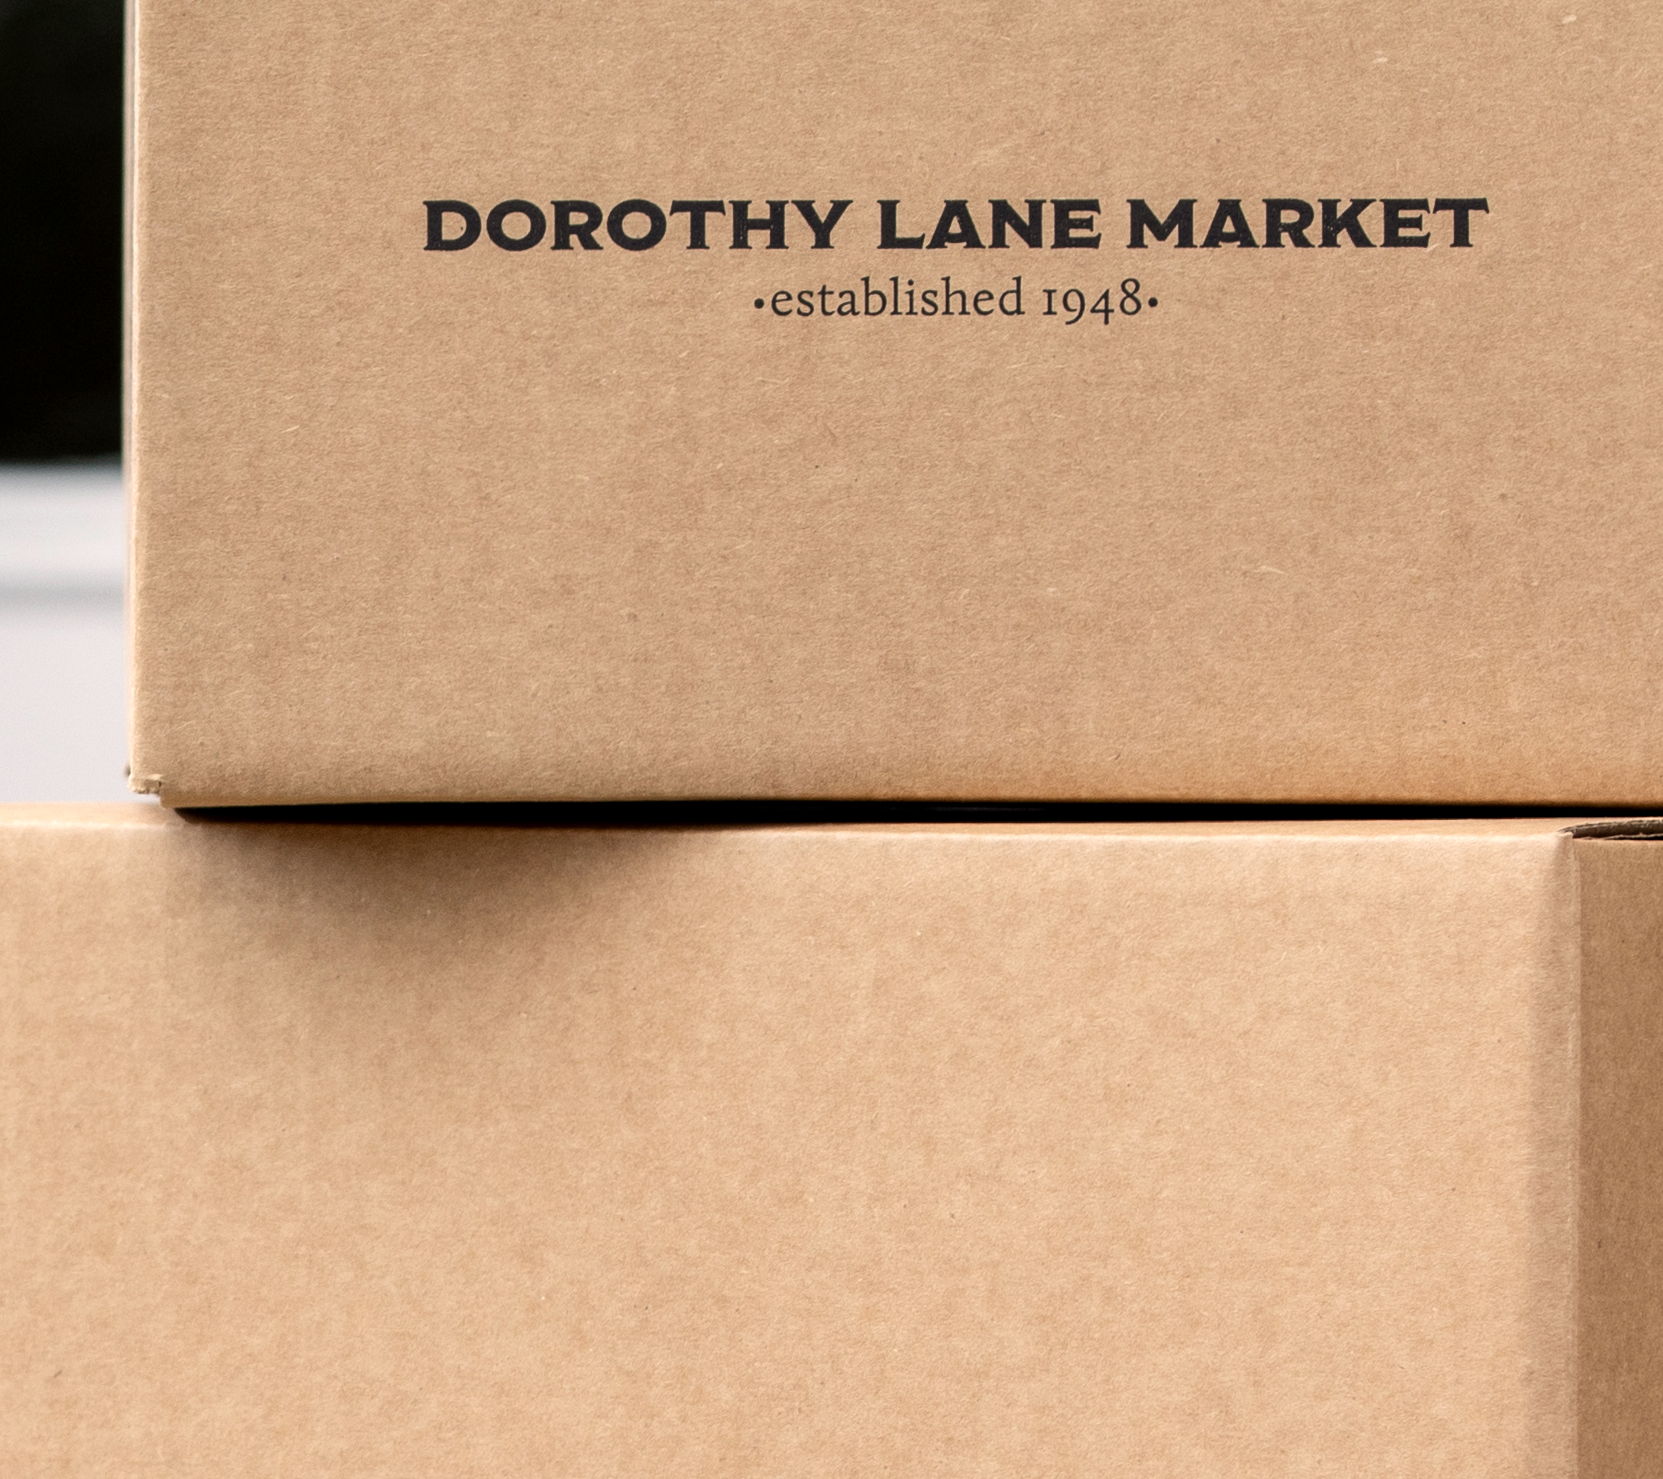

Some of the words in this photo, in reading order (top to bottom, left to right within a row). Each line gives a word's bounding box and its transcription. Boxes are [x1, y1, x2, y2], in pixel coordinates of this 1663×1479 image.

[422, 198, 854, 252] DOROTHY
[876, 198, 1102, 251] LANE
[1126, 197, 1490, 250] MARKET
